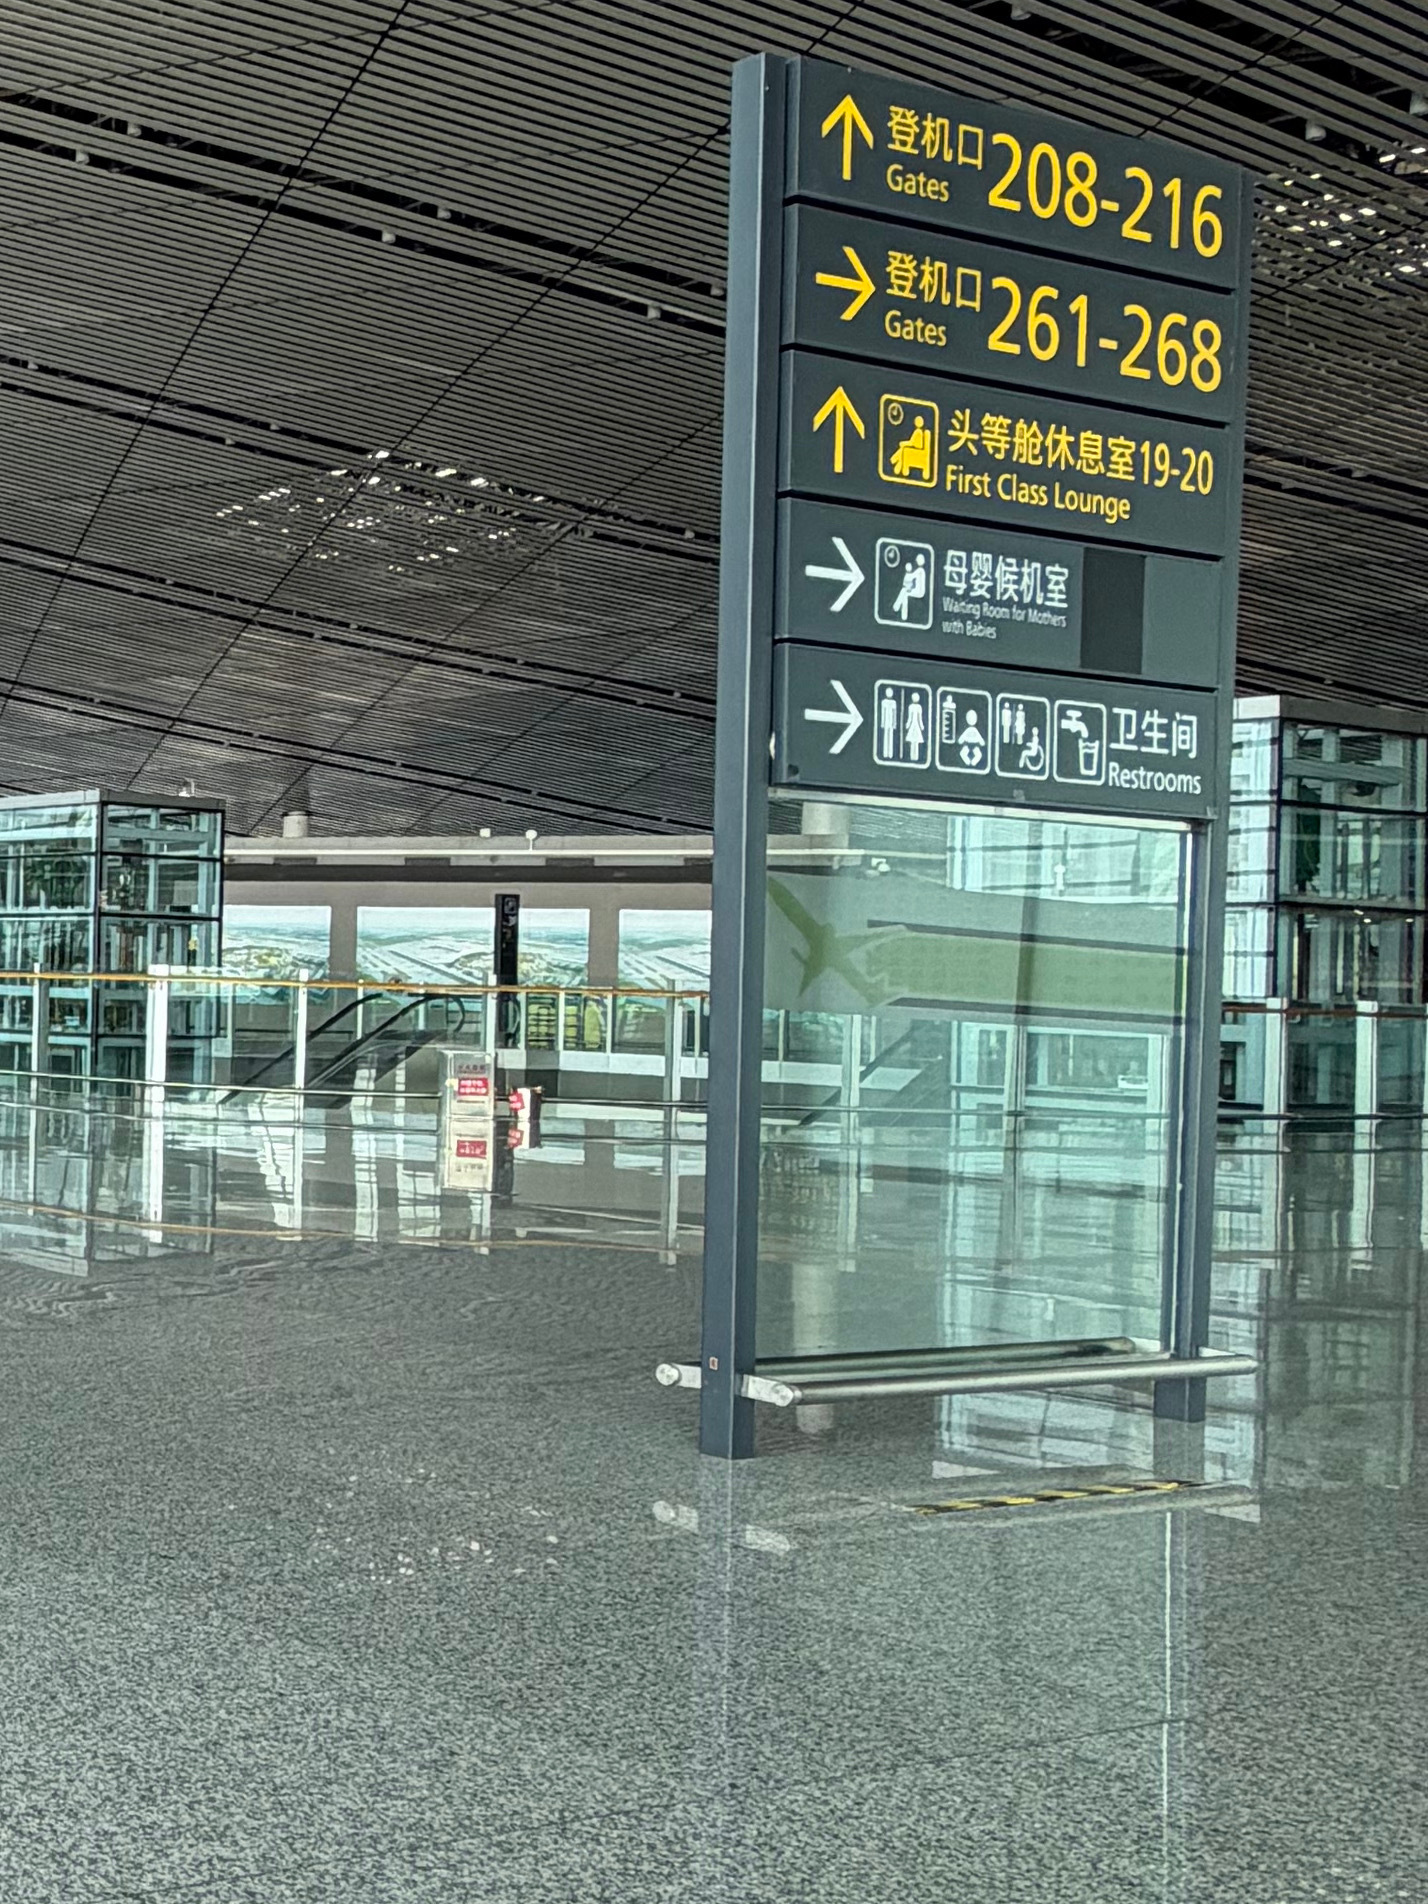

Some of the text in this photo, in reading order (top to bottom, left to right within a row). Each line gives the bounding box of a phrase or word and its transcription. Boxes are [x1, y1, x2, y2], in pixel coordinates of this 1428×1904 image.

[886, 163, 949, 202] Gates
[887, 105, 1222, 258] 登机口 208-216
[884, 310, 947, 346] Gates
[886, 251, 1221, 392] 登机口 261-268
[946, 464, 1131, 524] First Class Lounge
[943, 549, 1069, 608] 母婴候机室
[942, 596, 1067, 628] Waiting Room for Mothers
[942, 619, 997, 639] with Babies
[1109, 707, 1198, 759] 卫生间
[1108, 761, 1202, 795] Restrooms
